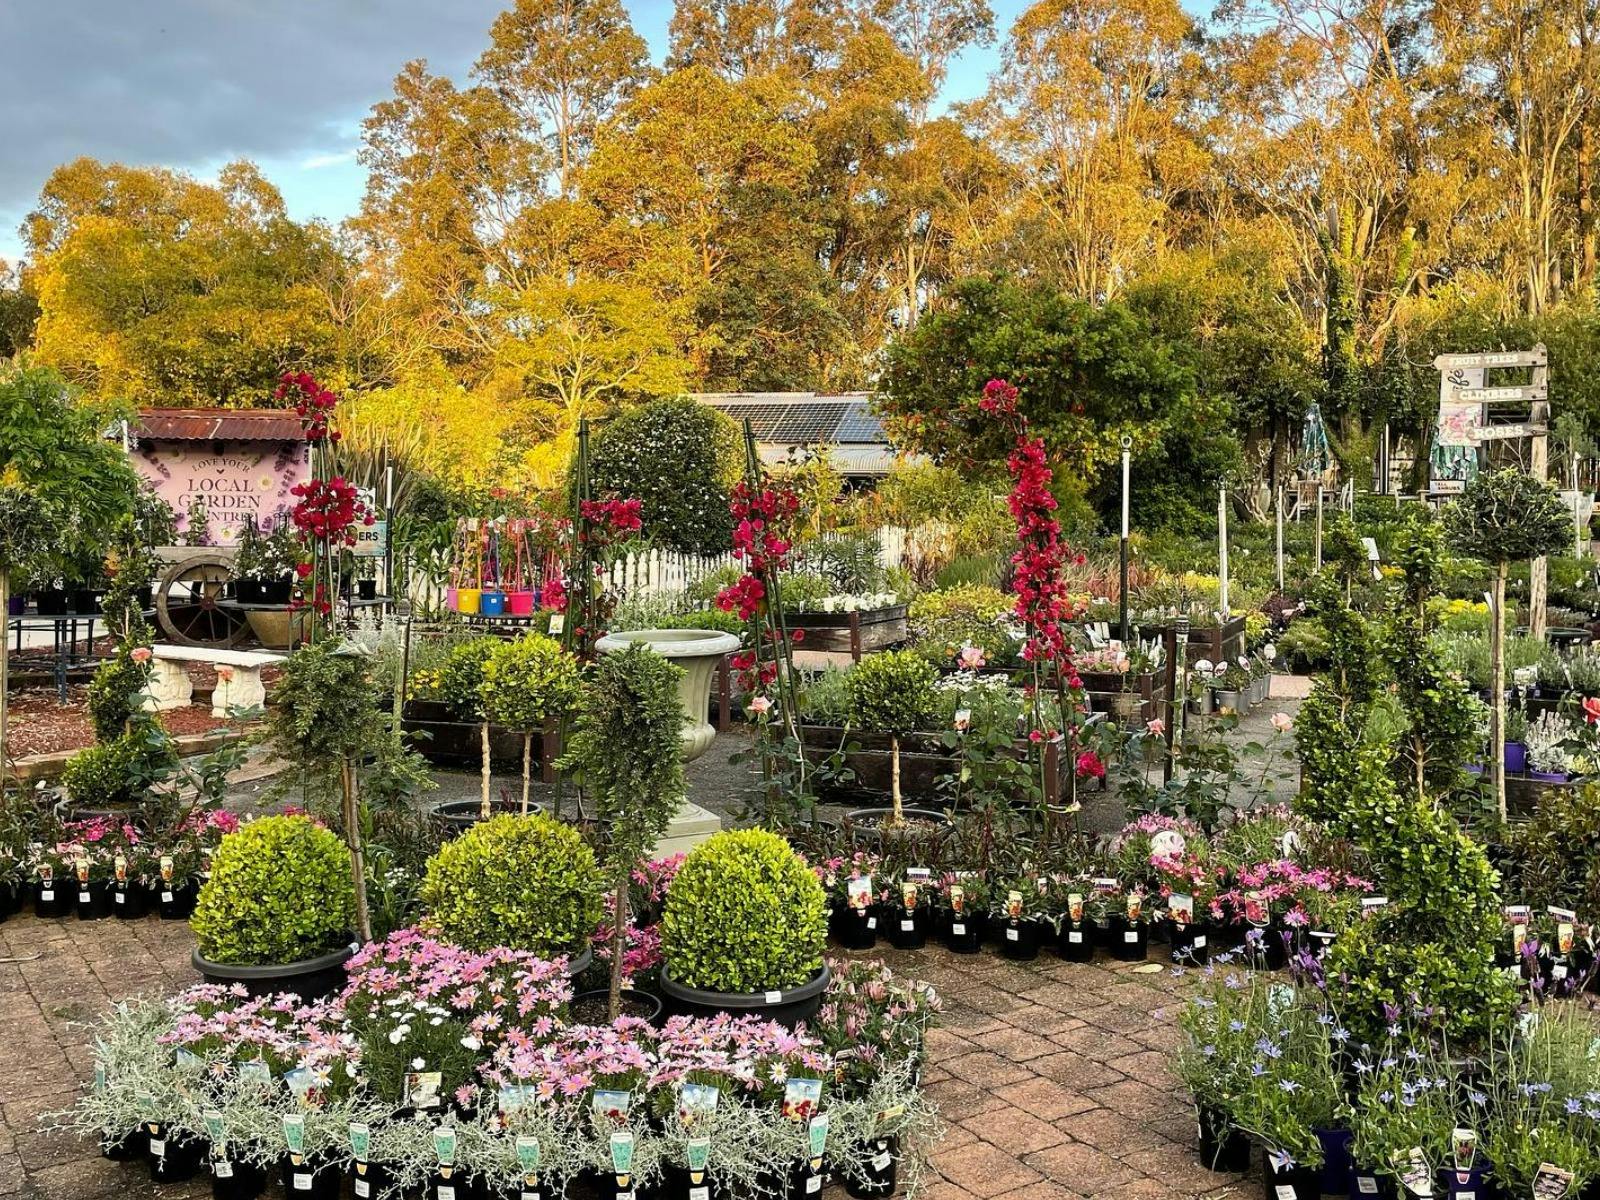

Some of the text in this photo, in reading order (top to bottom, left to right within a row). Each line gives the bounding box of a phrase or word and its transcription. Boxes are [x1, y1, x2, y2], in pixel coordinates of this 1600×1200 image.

[1484, 354, 1519, 364] TREES
[1459, 388, 1523, 400] CLIMBERS
[1473, 425, 1524, 439] ROSES
[191, 458, 250, 473] LOVE YOUR
[187, 478, 254, 492] LOCAL
[178, 494, 261, 508] GRDEN
